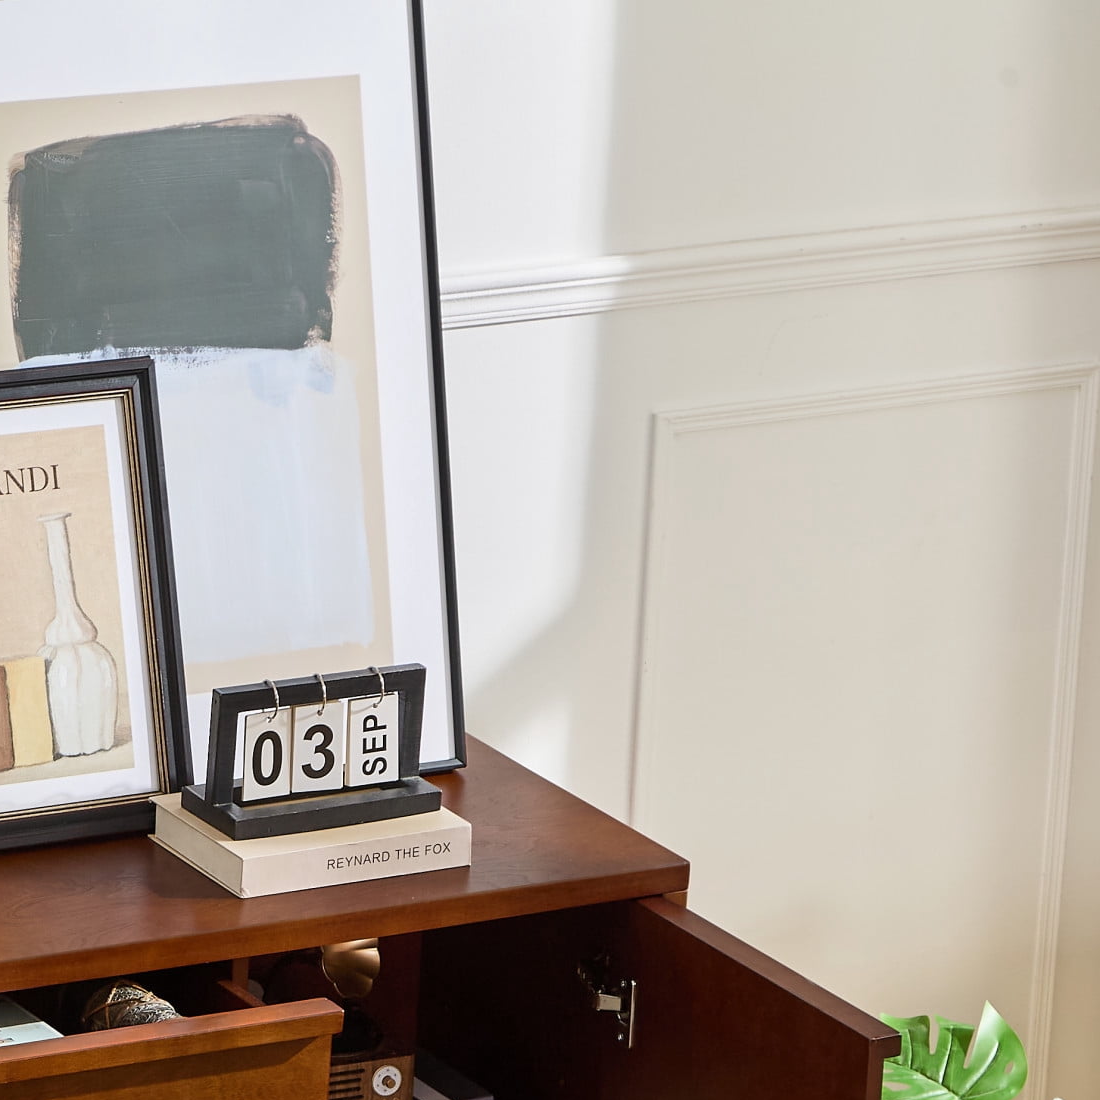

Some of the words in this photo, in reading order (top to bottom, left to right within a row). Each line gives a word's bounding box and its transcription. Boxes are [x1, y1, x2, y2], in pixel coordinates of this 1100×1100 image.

[363, 714, 388, 776] SEP
[327, 851, 390, 870] REYNARD
[395, 848, 420, 859] THE
[425, 842, 451, 857] FOX
